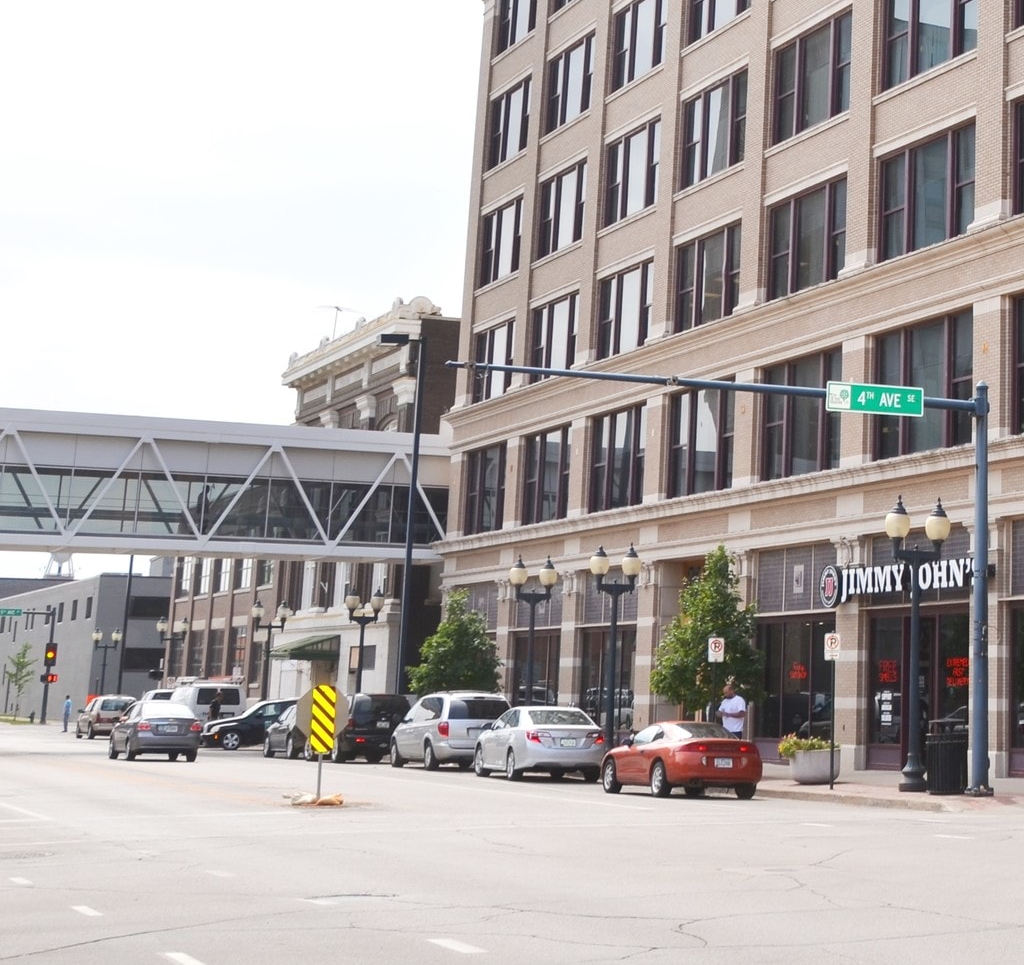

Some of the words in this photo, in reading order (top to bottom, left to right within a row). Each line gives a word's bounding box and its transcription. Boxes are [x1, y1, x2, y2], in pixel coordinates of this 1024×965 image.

[857, 391, 875, 406] 4TH
[879, 392, 902, 408] AVE
[907, 394, 916, 403] SE
[841, 564, 905, 603] JIMMY
[910, 557, 976, 599] OHN'
